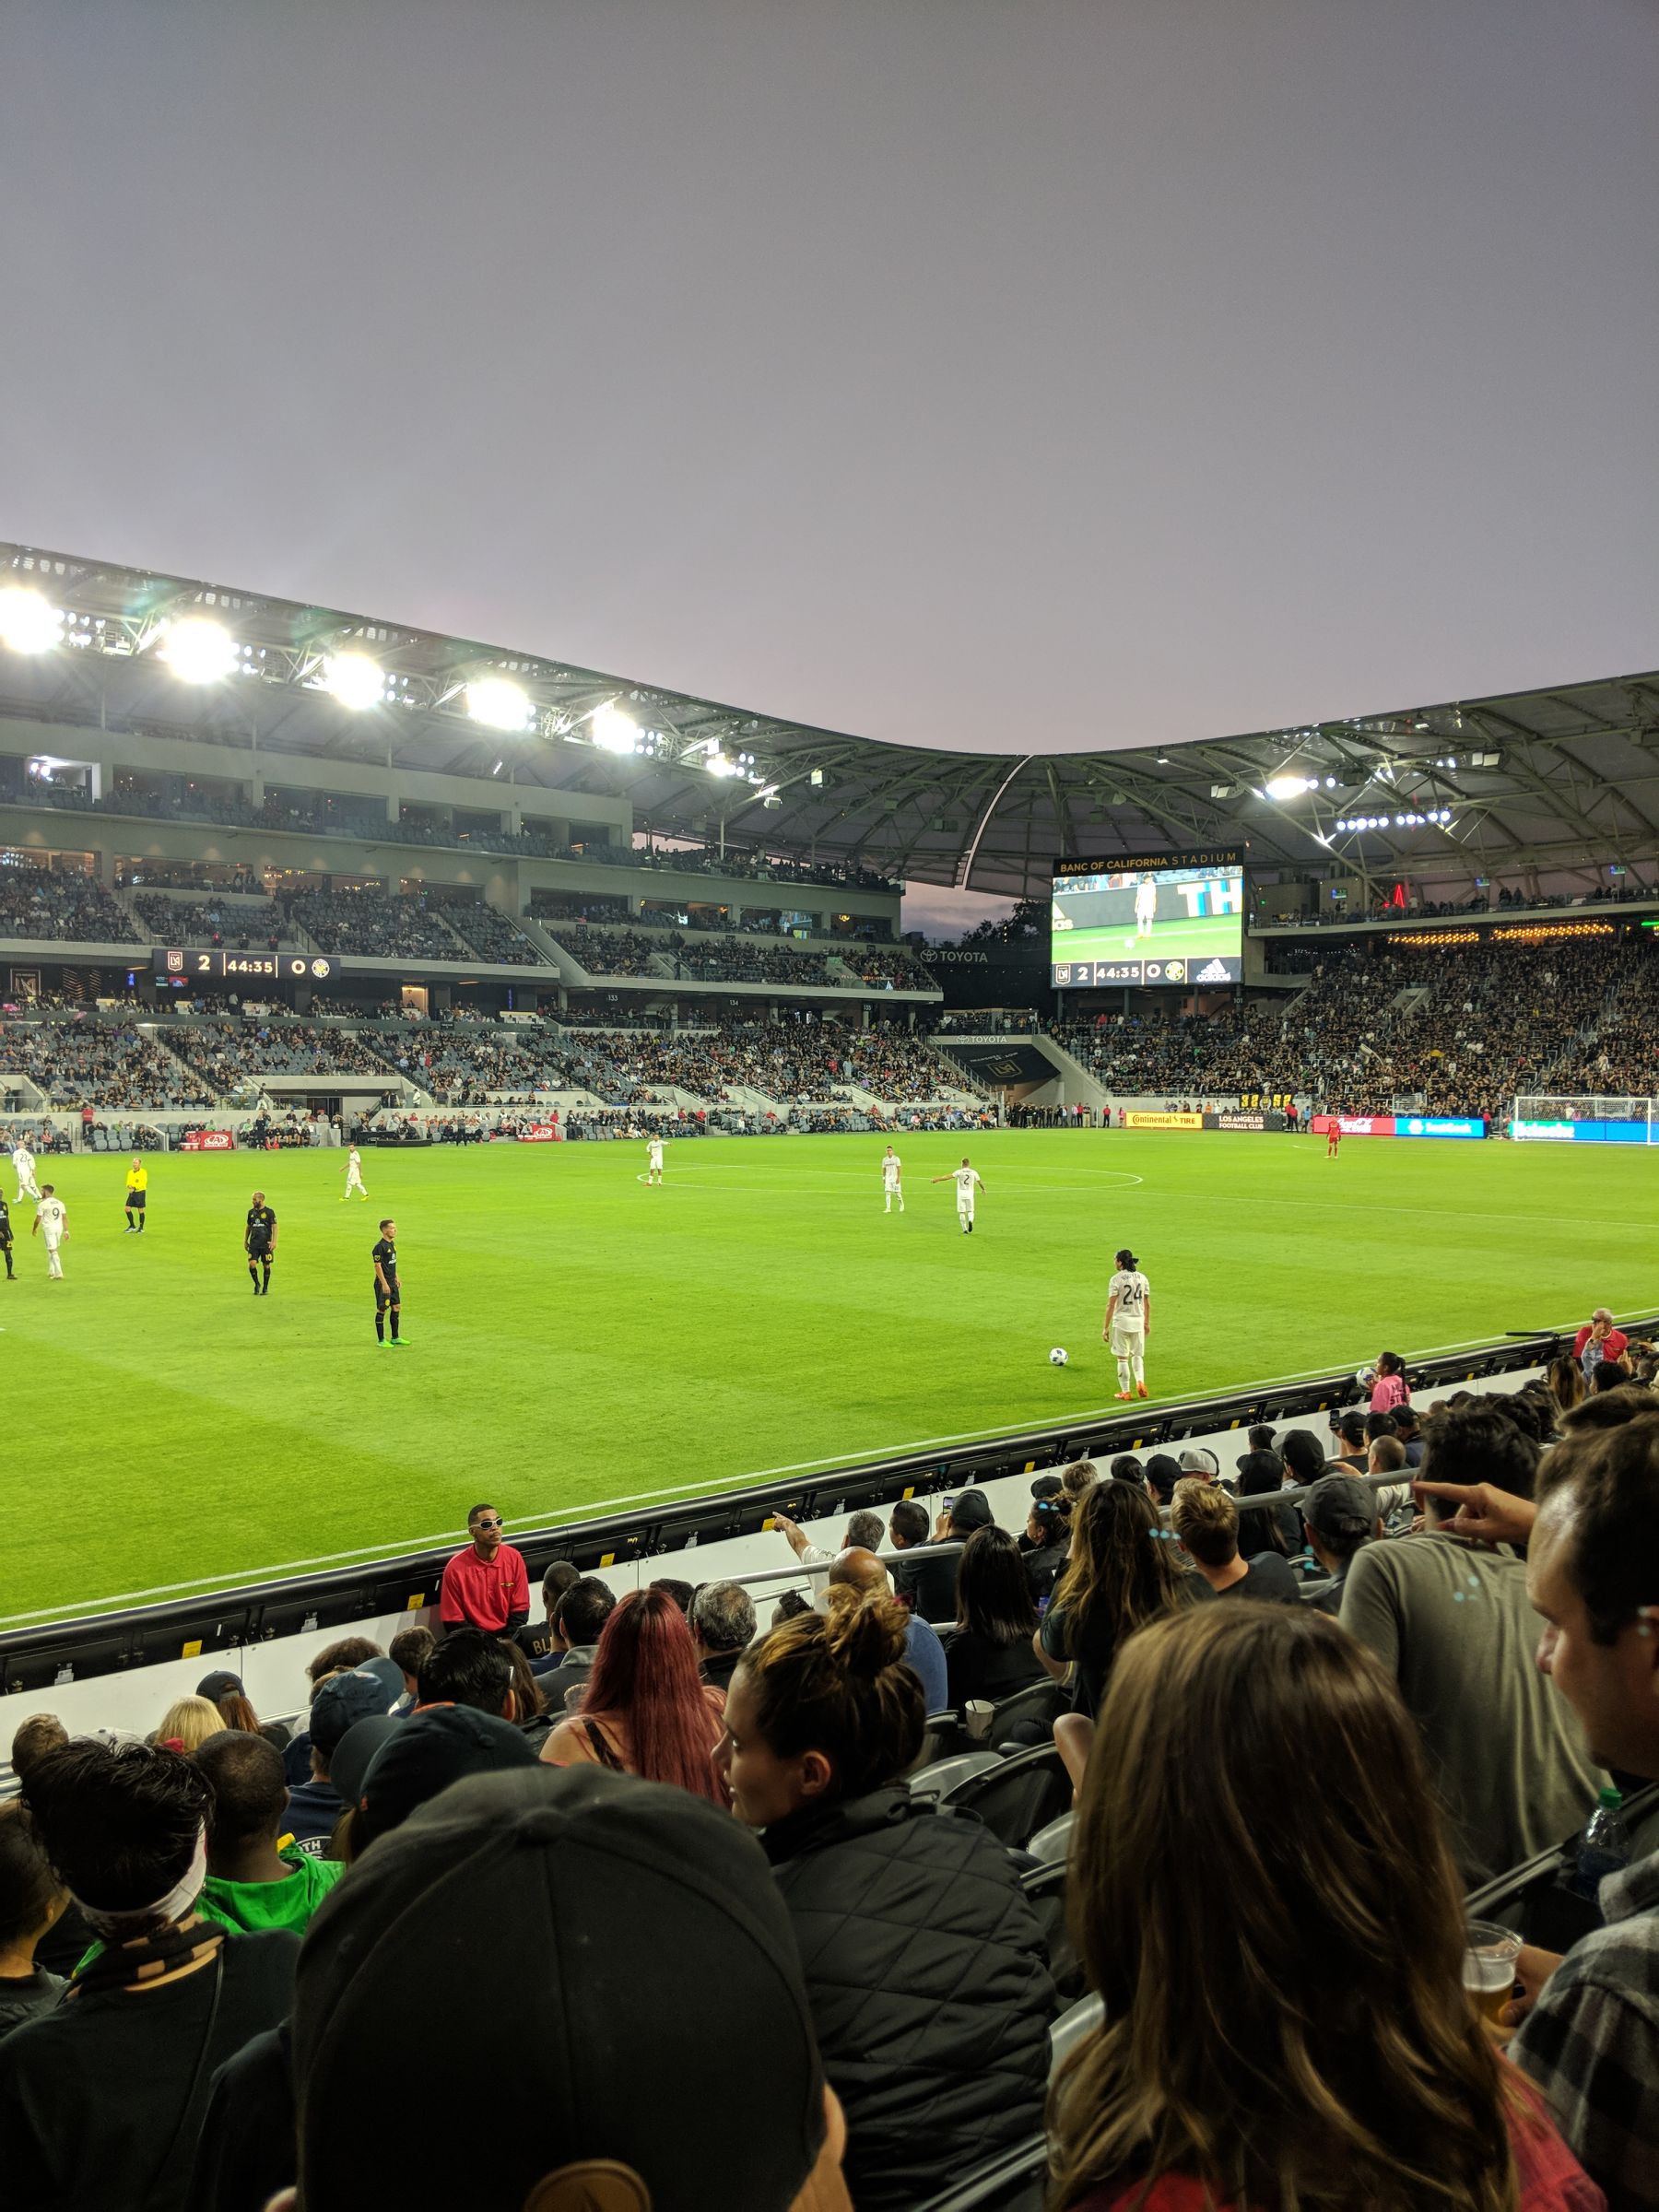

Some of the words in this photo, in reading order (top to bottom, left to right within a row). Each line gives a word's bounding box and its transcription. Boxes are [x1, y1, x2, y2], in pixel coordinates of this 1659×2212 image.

[1060, 862, 1088, 873] BANC
[1090, 861, 1104, 871] OF
[1106, 856, 1169, 869] CALIFORNIA
[1171, 852, 1237, 865] STADIUM
[939, 950, 988, 963] TOYOTA
[198, 955, 210, 971] 2
[227, 960, 274, 973] 44:35
[1077, 967, 1088, 980] 2
[1096, 966, 1139, 979] 44:35
[971, 1035, 1007, 1043] TOYOTA
[1132, 1113, 1172, 1124] Continental
[1218, 1115, 1231, 1124] LOS
[1231, 1115, 1264, 1124] ANGELES
[19, 1153, 29, 1162] 23
[963, 1174, 970, 1185] 2
[52, 1207, 60, 1220] 9
[1123, 1283, 1142, 1305] 24
[533, 1637, 552, 1655] BL
